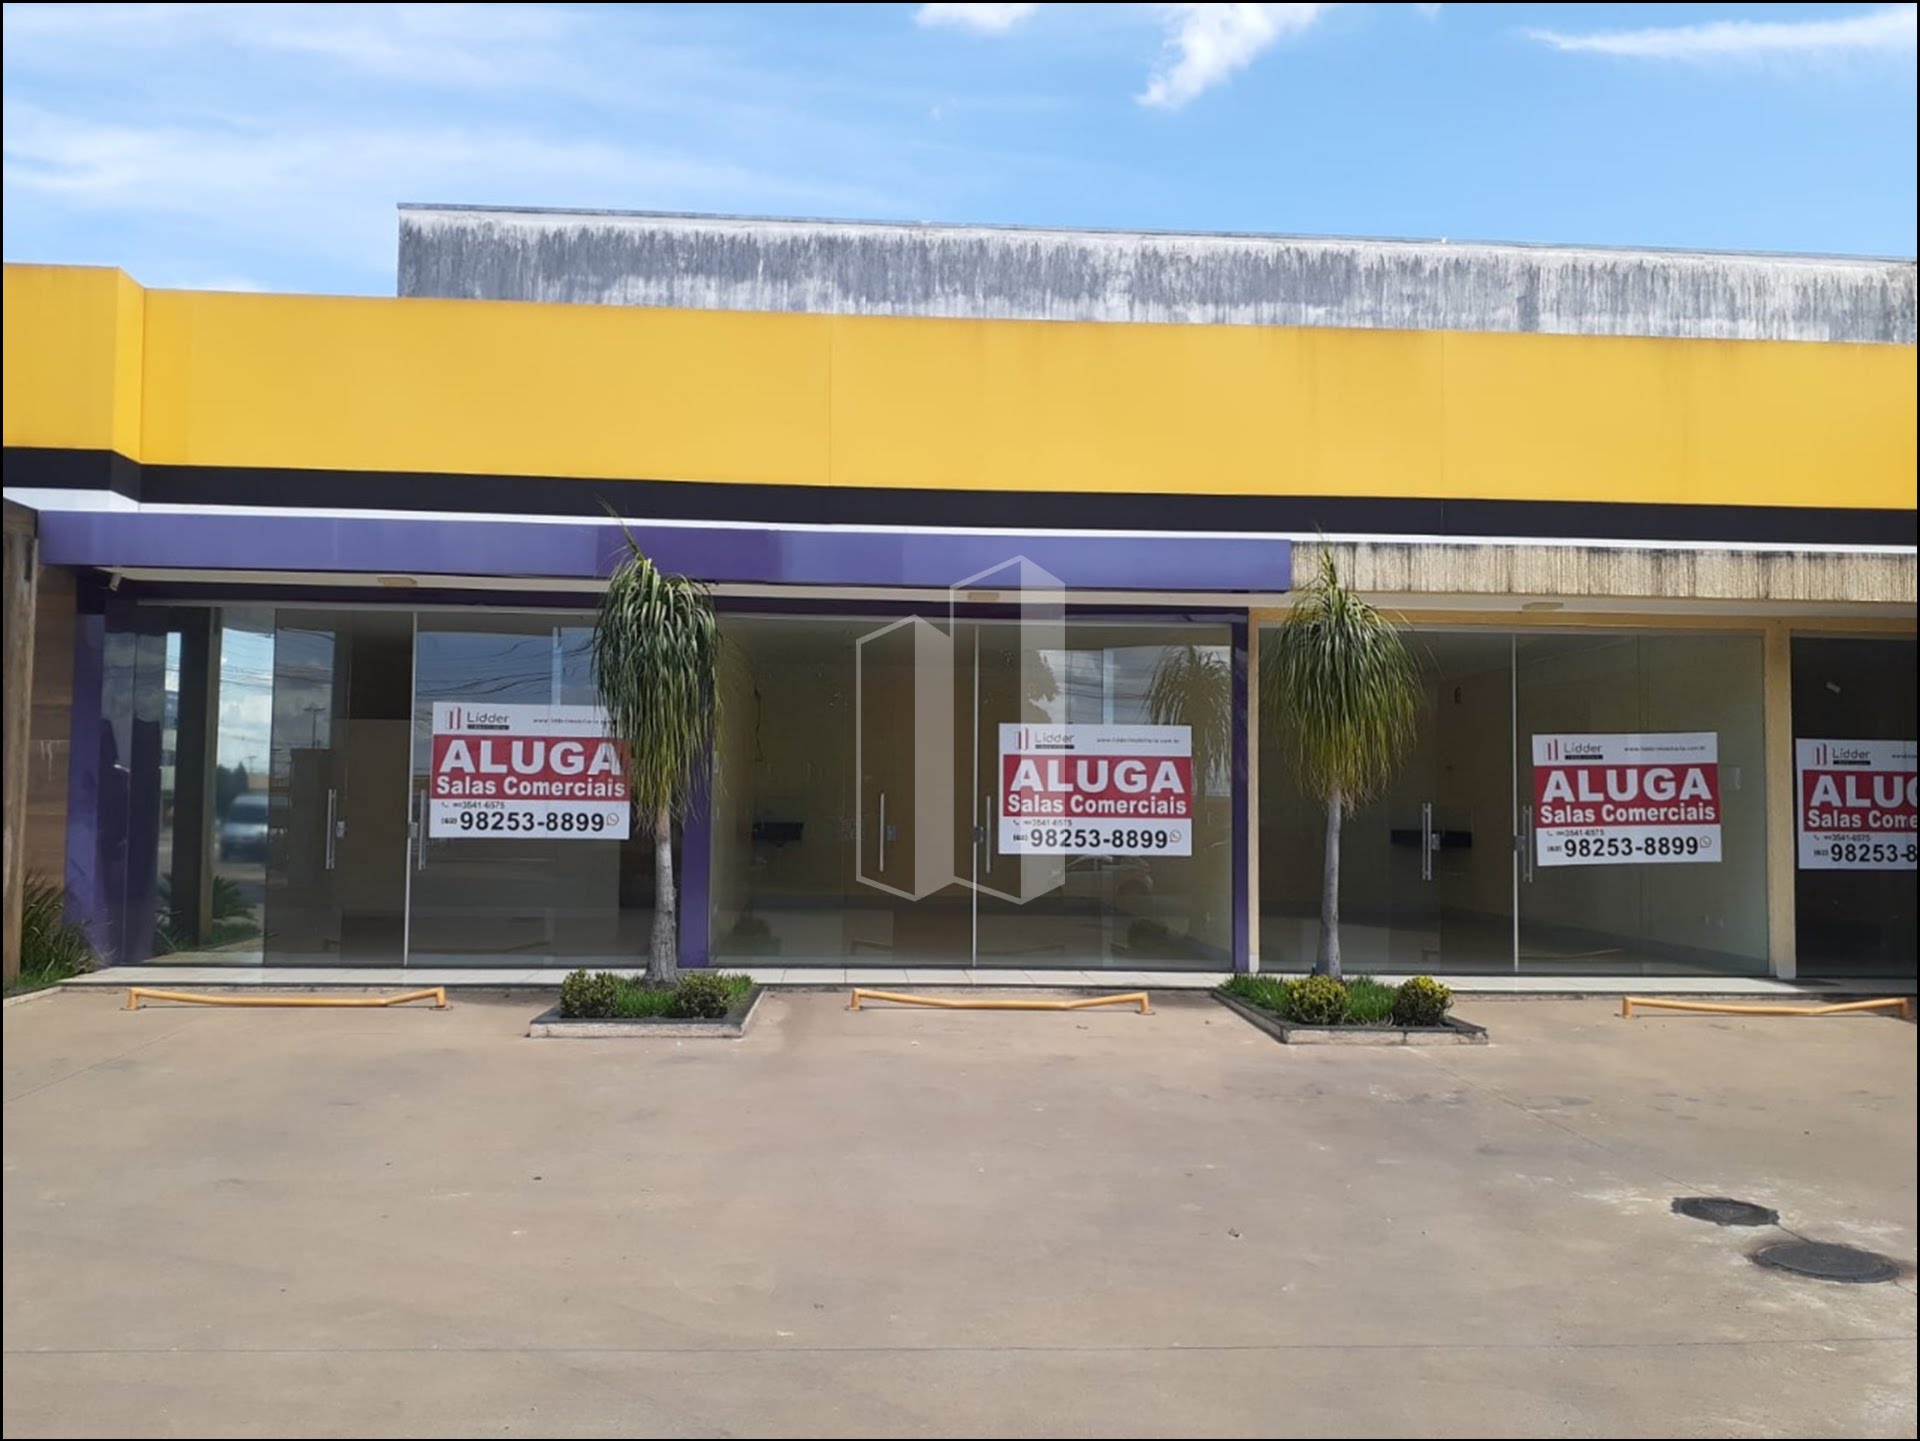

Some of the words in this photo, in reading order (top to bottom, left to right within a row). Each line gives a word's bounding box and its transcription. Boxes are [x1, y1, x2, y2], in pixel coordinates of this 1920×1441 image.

[439, 739, 621, 775] ALUGA
[436, 776, 496, 795] Salas
[503, 777, 625, 797] Comerciais
[1010, 759, 1184, 794] ALUGA
[1542, 768, 1712, 803] ALUGA
[1008, 794, 1064, 813] Salas
[1070, 795, 1186, 815] Comerciais
[1540, 804, 1595, 824] Salas
[1602, 802, 1716, 823] Comerciais
[460, 811, 604, 832] 98253-8899
[1808, 809, 1862, 827] Salas
[1030, 829, 1167, 849] 98253-8899
[1564, 837, 1698, 857] 98253-8899
